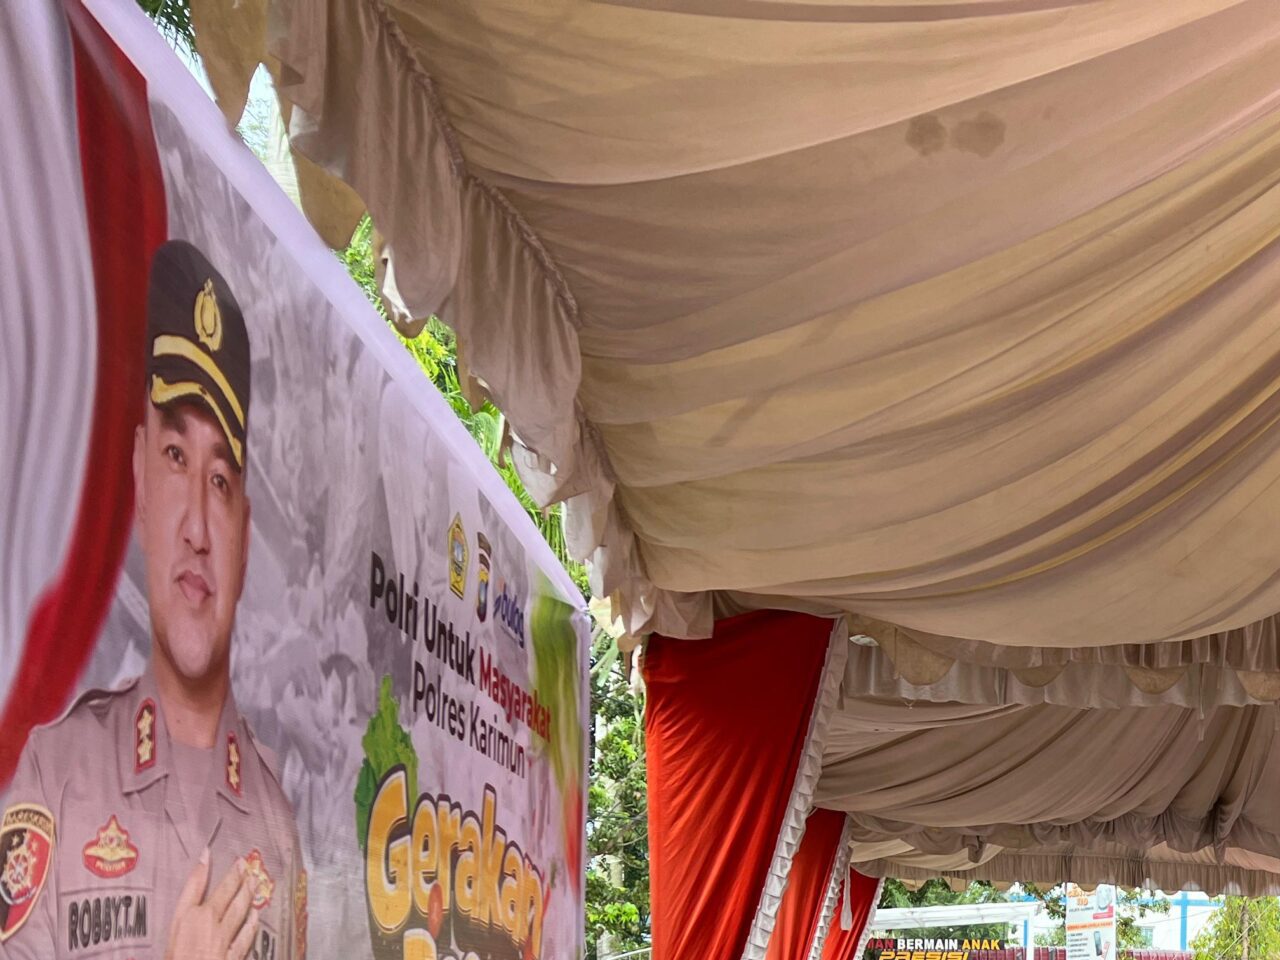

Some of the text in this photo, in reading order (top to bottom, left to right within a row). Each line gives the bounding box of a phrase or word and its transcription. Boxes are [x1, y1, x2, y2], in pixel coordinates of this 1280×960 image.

[370, 551, 551, 743] Polri Untuk Masyarakat
[413, 660, 525, 779] Polres Karimun
[366, 764, 545, 955] Gerakan
[897, 938, 958, 950] BERMAIN
[962, 938, 1000, 950] ANAK
